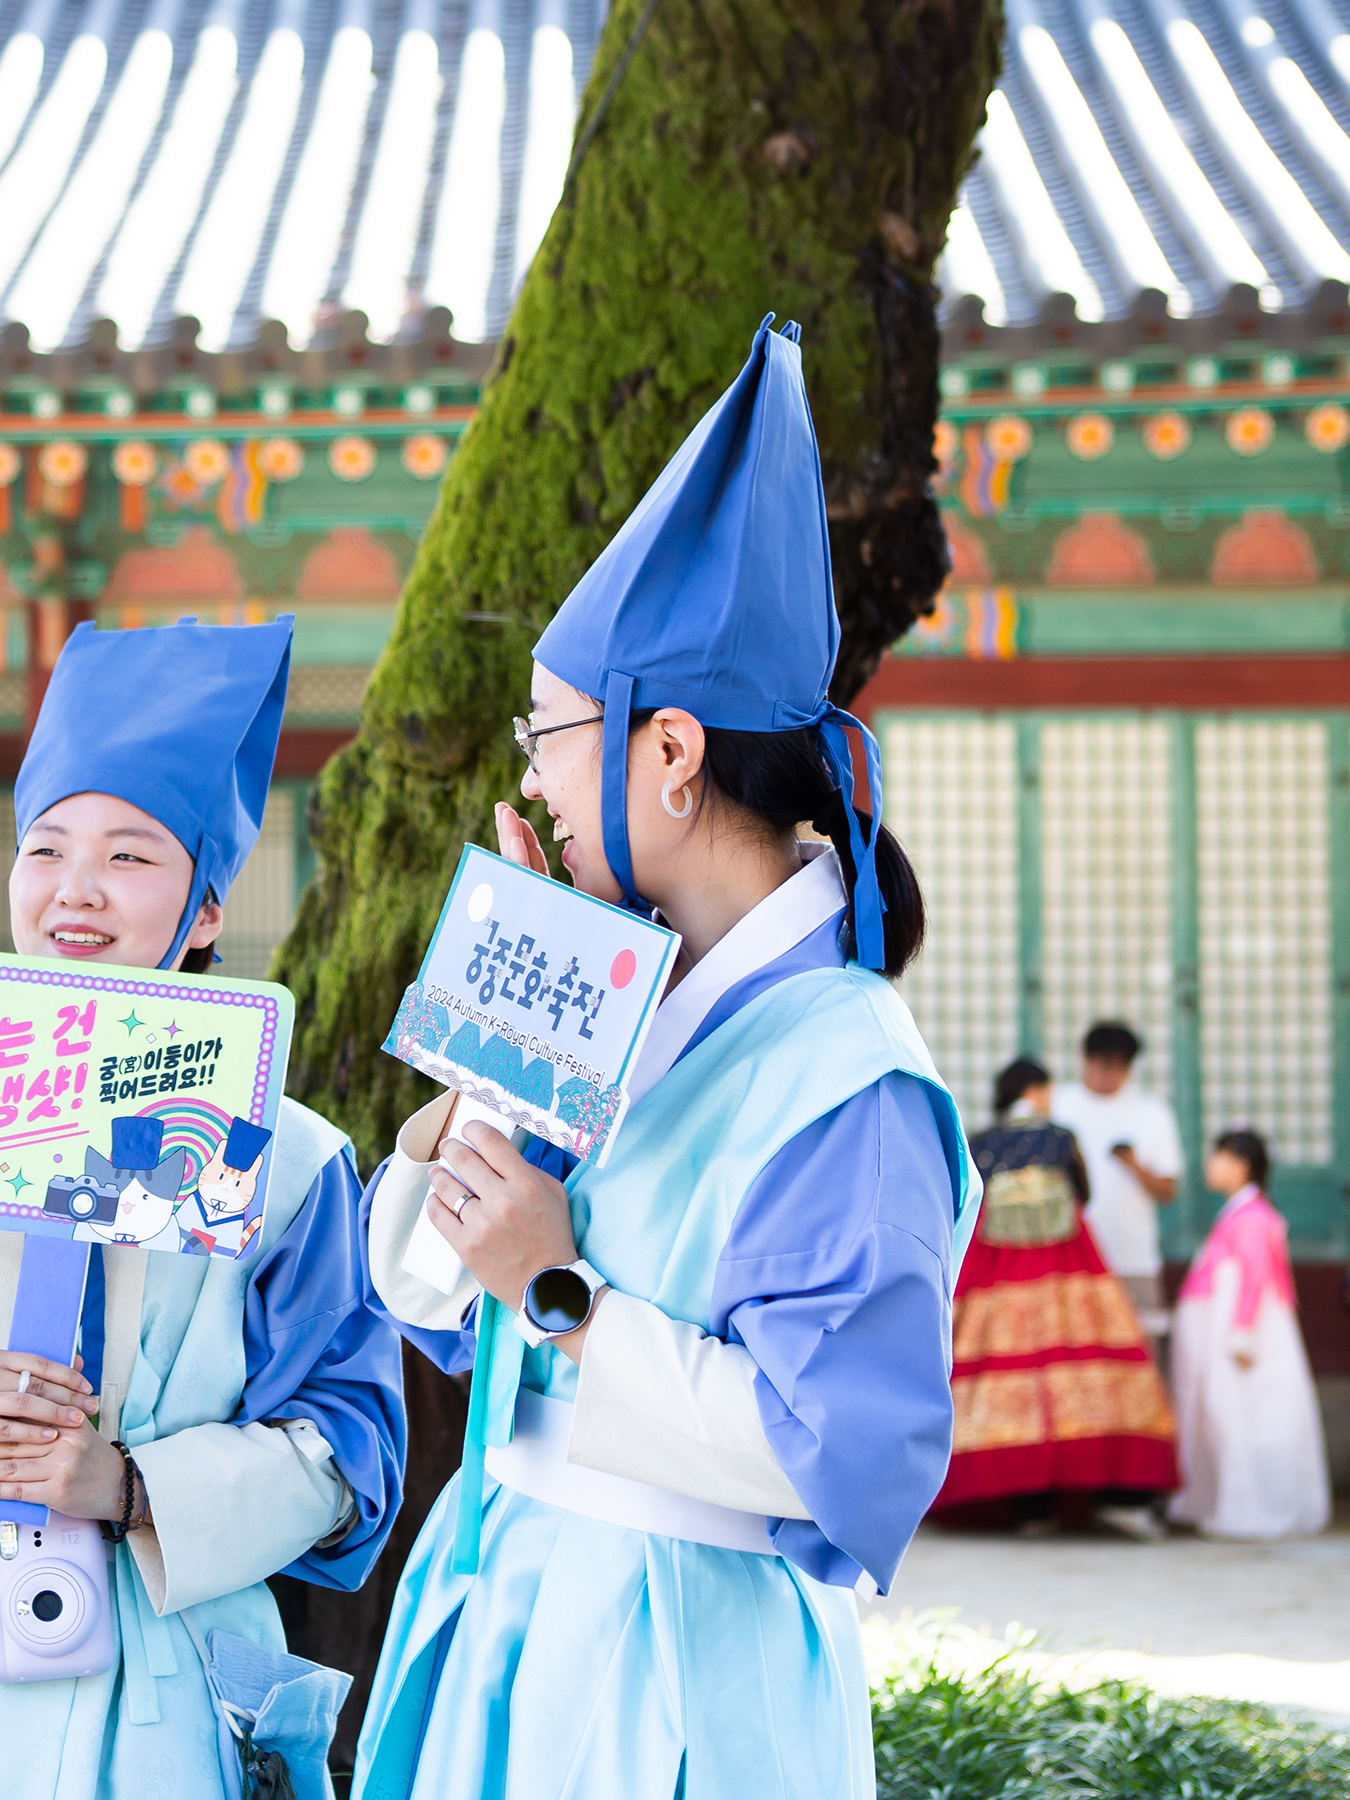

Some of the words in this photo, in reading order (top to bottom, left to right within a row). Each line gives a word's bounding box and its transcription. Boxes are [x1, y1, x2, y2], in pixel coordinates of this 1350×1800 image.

[465, 916, 606, 1040] 궁중문화축전
[52, 999, 97, 1057] 건
[427, 985, 454, 1009] 2024
[453, 998, 489, 1027] Autumn
[488, 1015, 530, 1048] K-Royal
[529, 1036, 564, 1065] Culture
[563, 1054, 605, 1087] Festival
[100, 1063, 215, 1104] 찍어드려요!!
